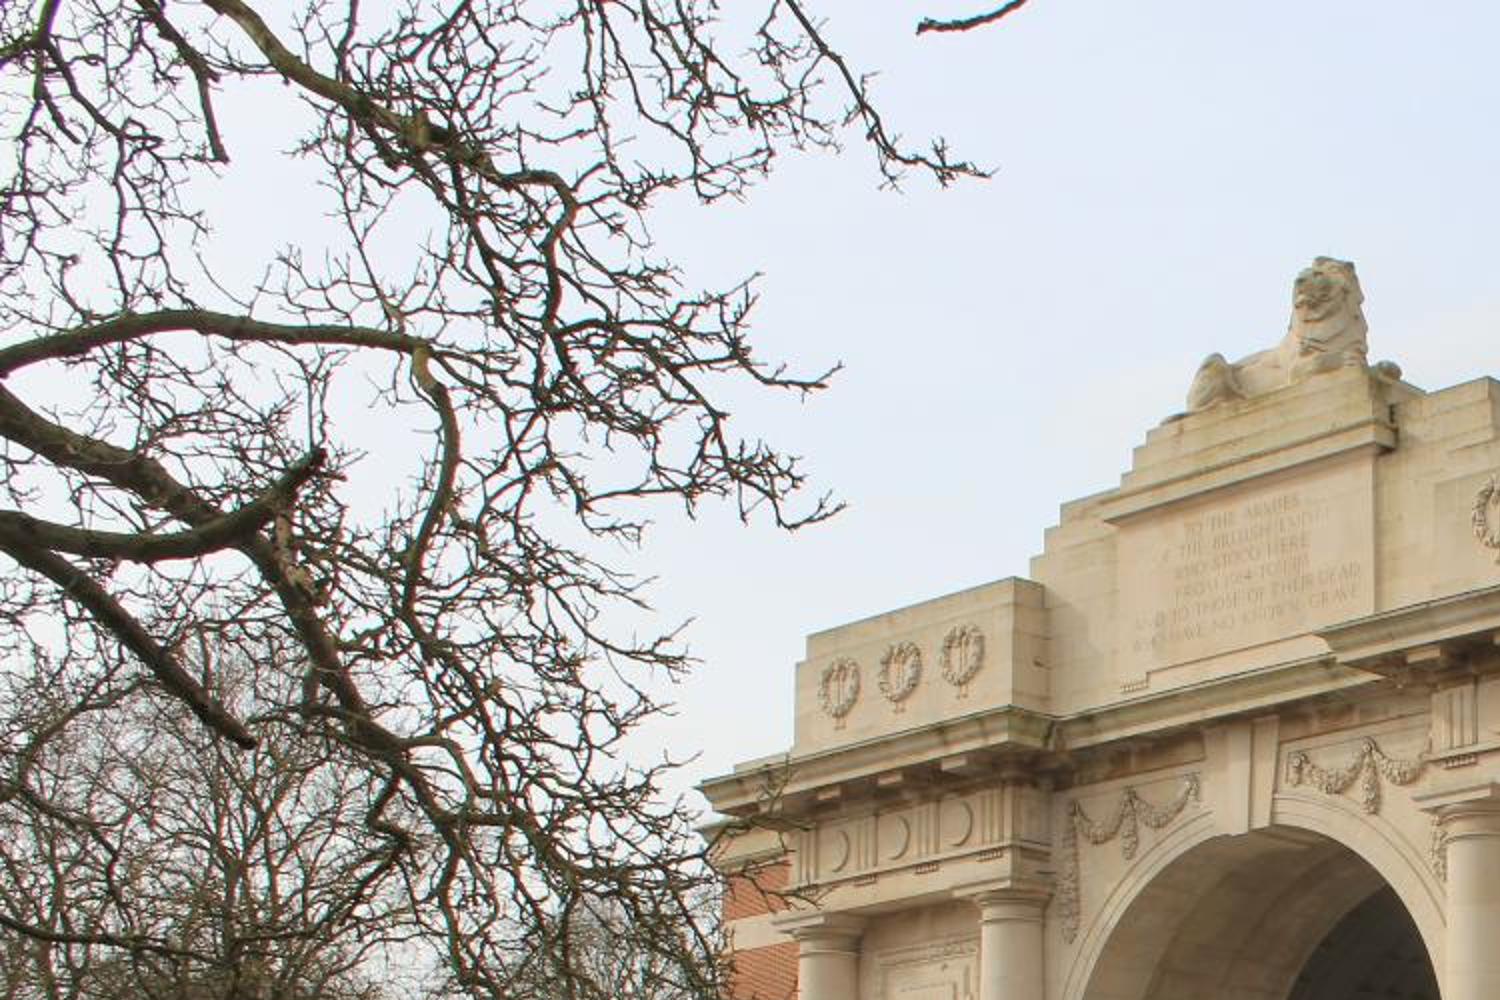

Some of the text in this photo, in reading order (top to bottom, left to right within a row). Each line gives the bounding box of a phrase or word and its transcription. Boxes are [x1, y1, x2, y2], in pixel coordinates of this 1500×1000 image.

[1209, 513, 1235, 531] THE
[1266, 530, 1312, 555] HERE
[1196, 592, 1238, 616] THOSE
[1246, 587, 1265, 605] OF
[1271, 573, 1314, 597] THEIR
[1317, 560, 1362, 585] DEAD
[1308, 583, 1361, 608] GRAVE
